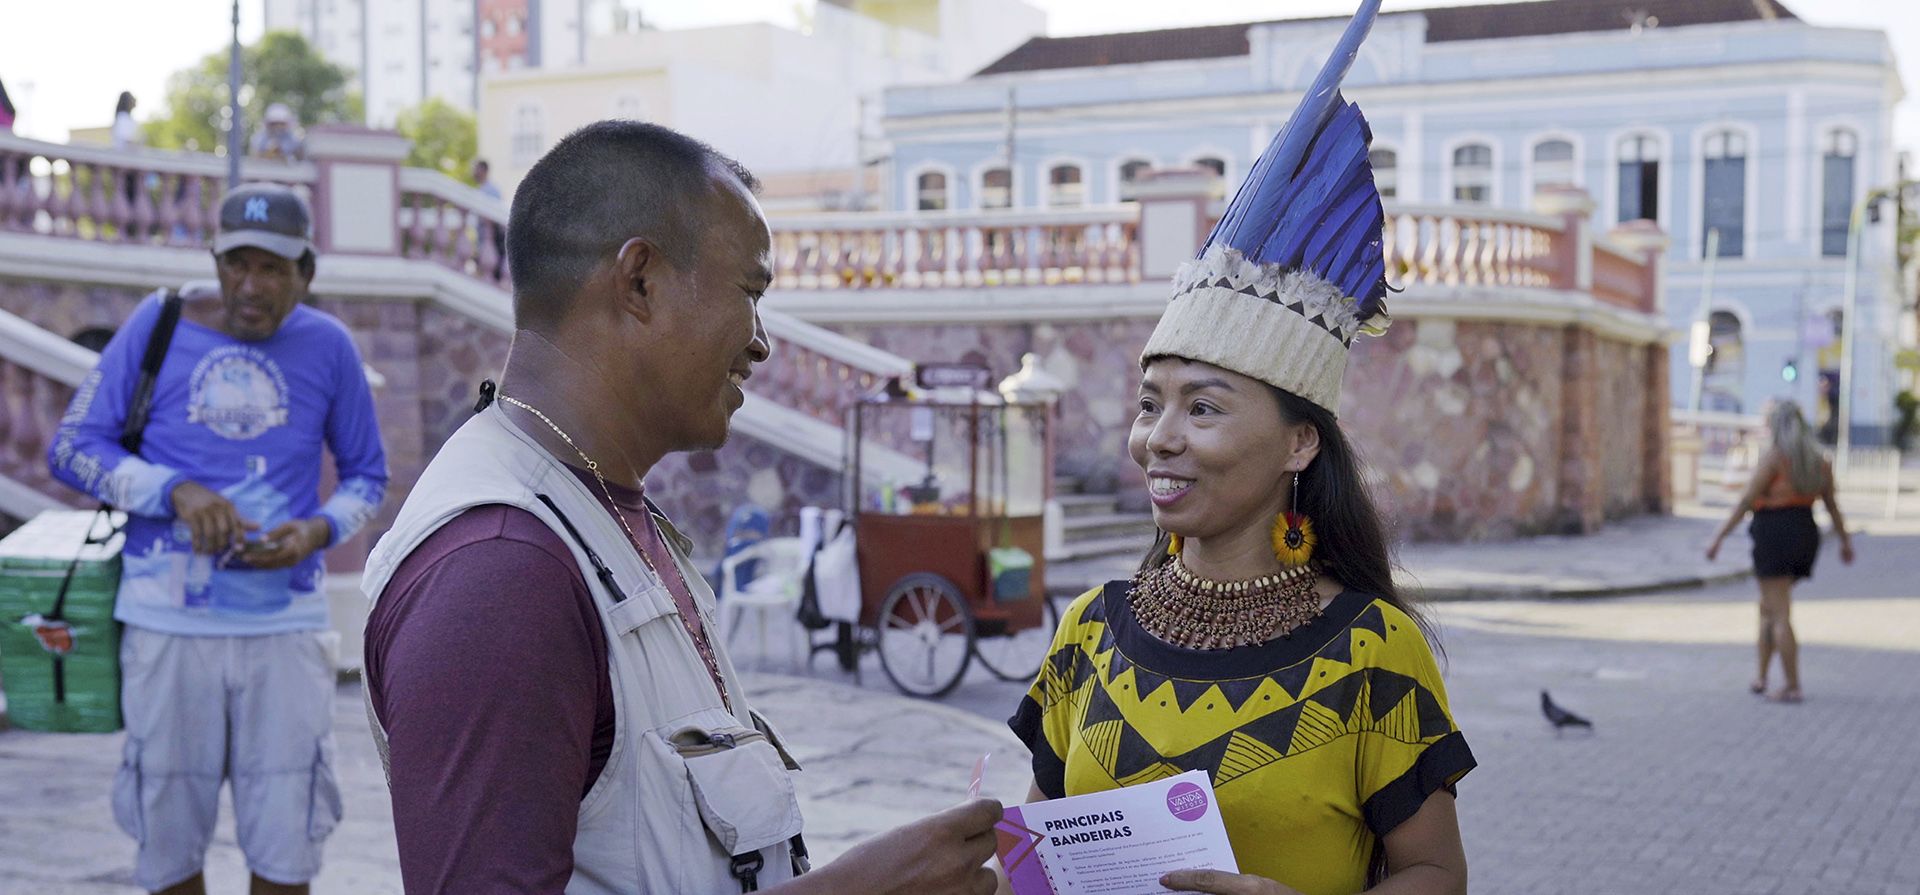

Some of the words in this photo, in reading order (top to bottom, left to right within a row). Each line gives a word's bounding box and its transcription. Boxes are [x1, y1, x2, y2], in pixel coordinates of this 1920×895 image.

[1168, 792, 1203, 807] VANDA
[1044, 810, 1125, 832] PRINCIPAIS
[1050, 826, 1133, 848] BANDEIRAS
